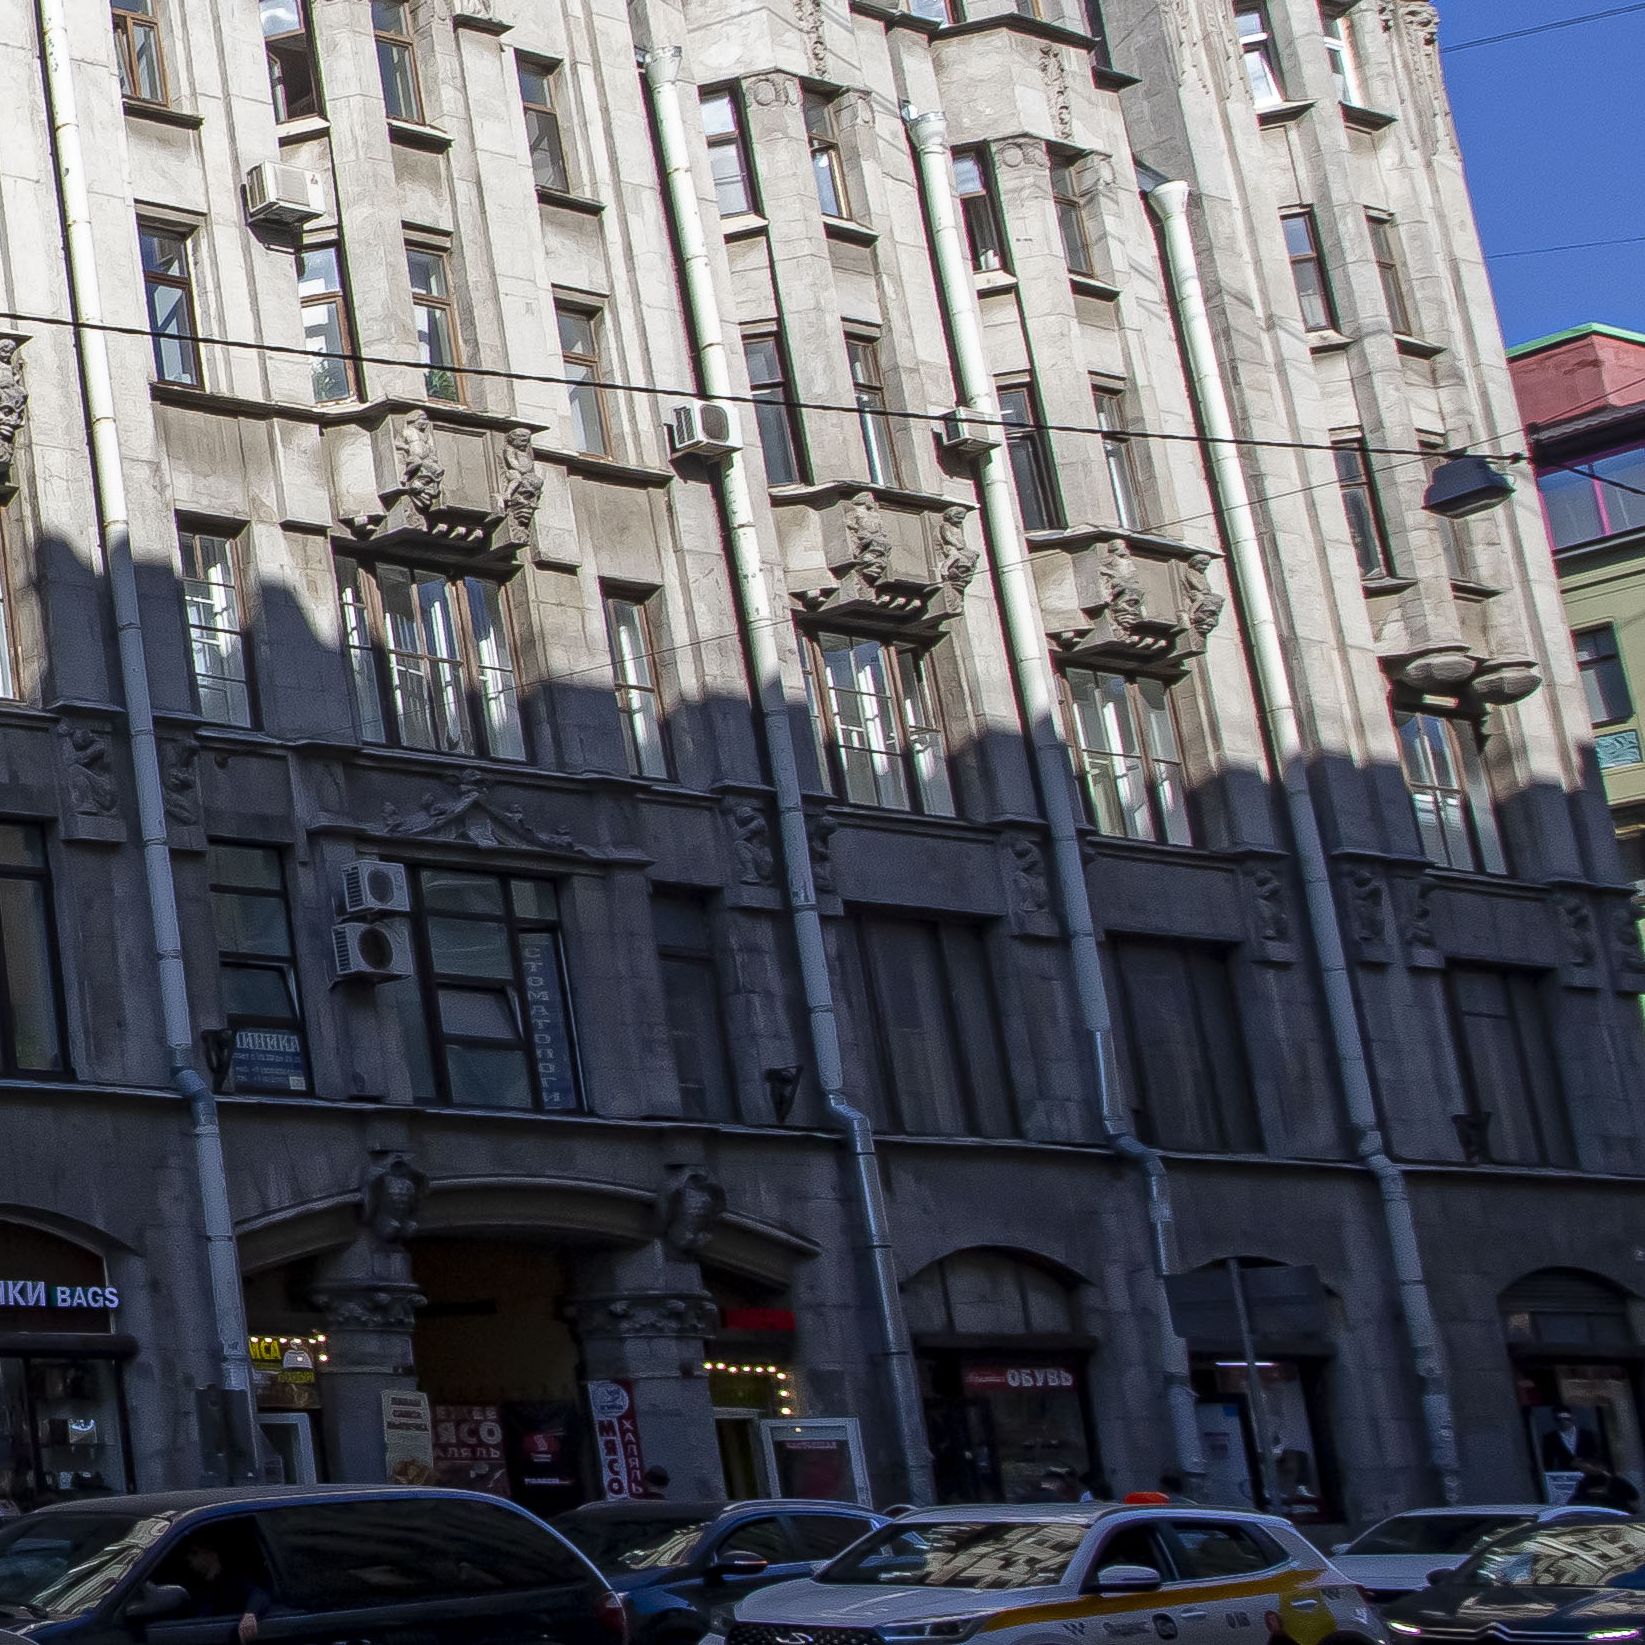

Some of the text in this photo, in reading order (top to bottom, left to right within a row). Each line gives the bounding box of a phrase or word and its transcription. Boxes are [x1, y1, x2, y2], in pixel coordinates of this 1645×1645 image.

[56, 1285, 120, 1308] BAGS
[1006, 1369, 1073, 1386] ОБУВЬ
[437, 1421, 502, 1445] ЯСО
[622, 1419, 644, 1494] ХАЛЯЛЬ
